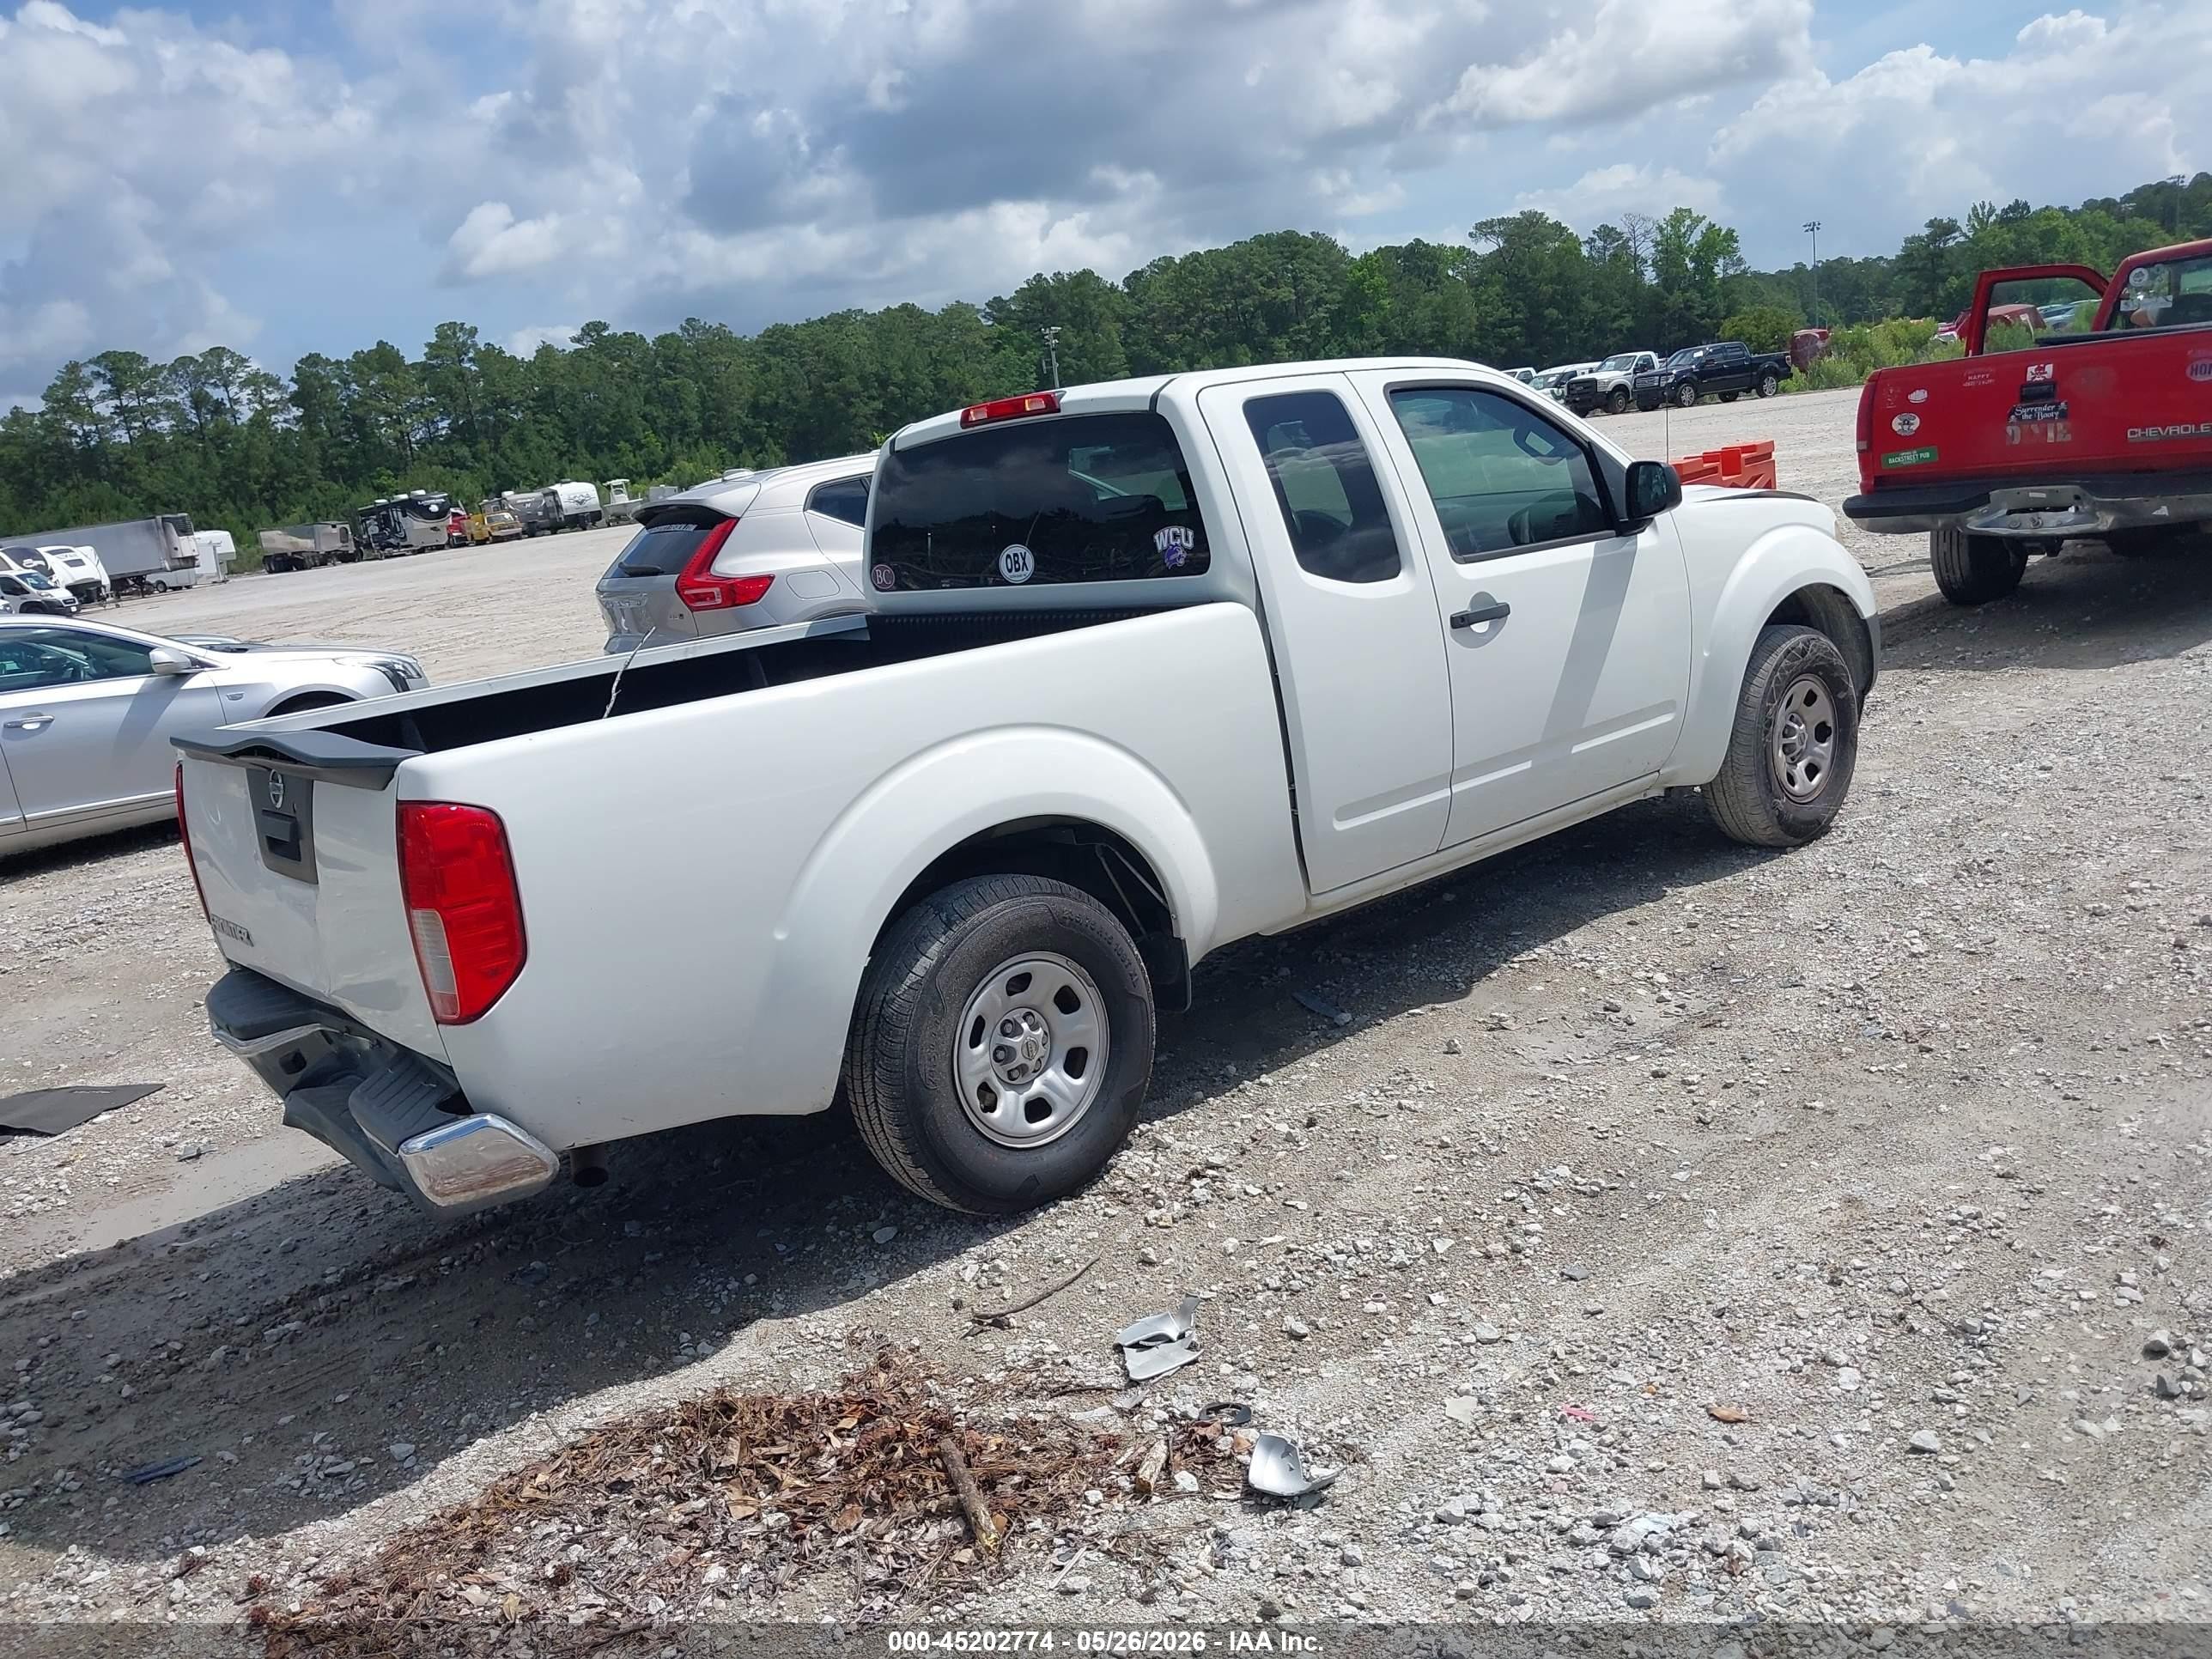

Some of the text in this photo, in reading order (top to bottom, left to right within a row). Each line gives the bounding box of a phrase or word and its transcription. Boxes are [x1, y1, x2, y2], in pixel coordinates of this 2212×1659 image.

[2014, 404, 2056, 416] Surrender
[2036, 411, 2059, 421] Booty
[1888, 453, 1919, 465] BACKSTREET
[1153, 526, 1194, 553] WCU
[1006, 551, 1030, 574] OBX
[875, 568, 891, 585] BC
